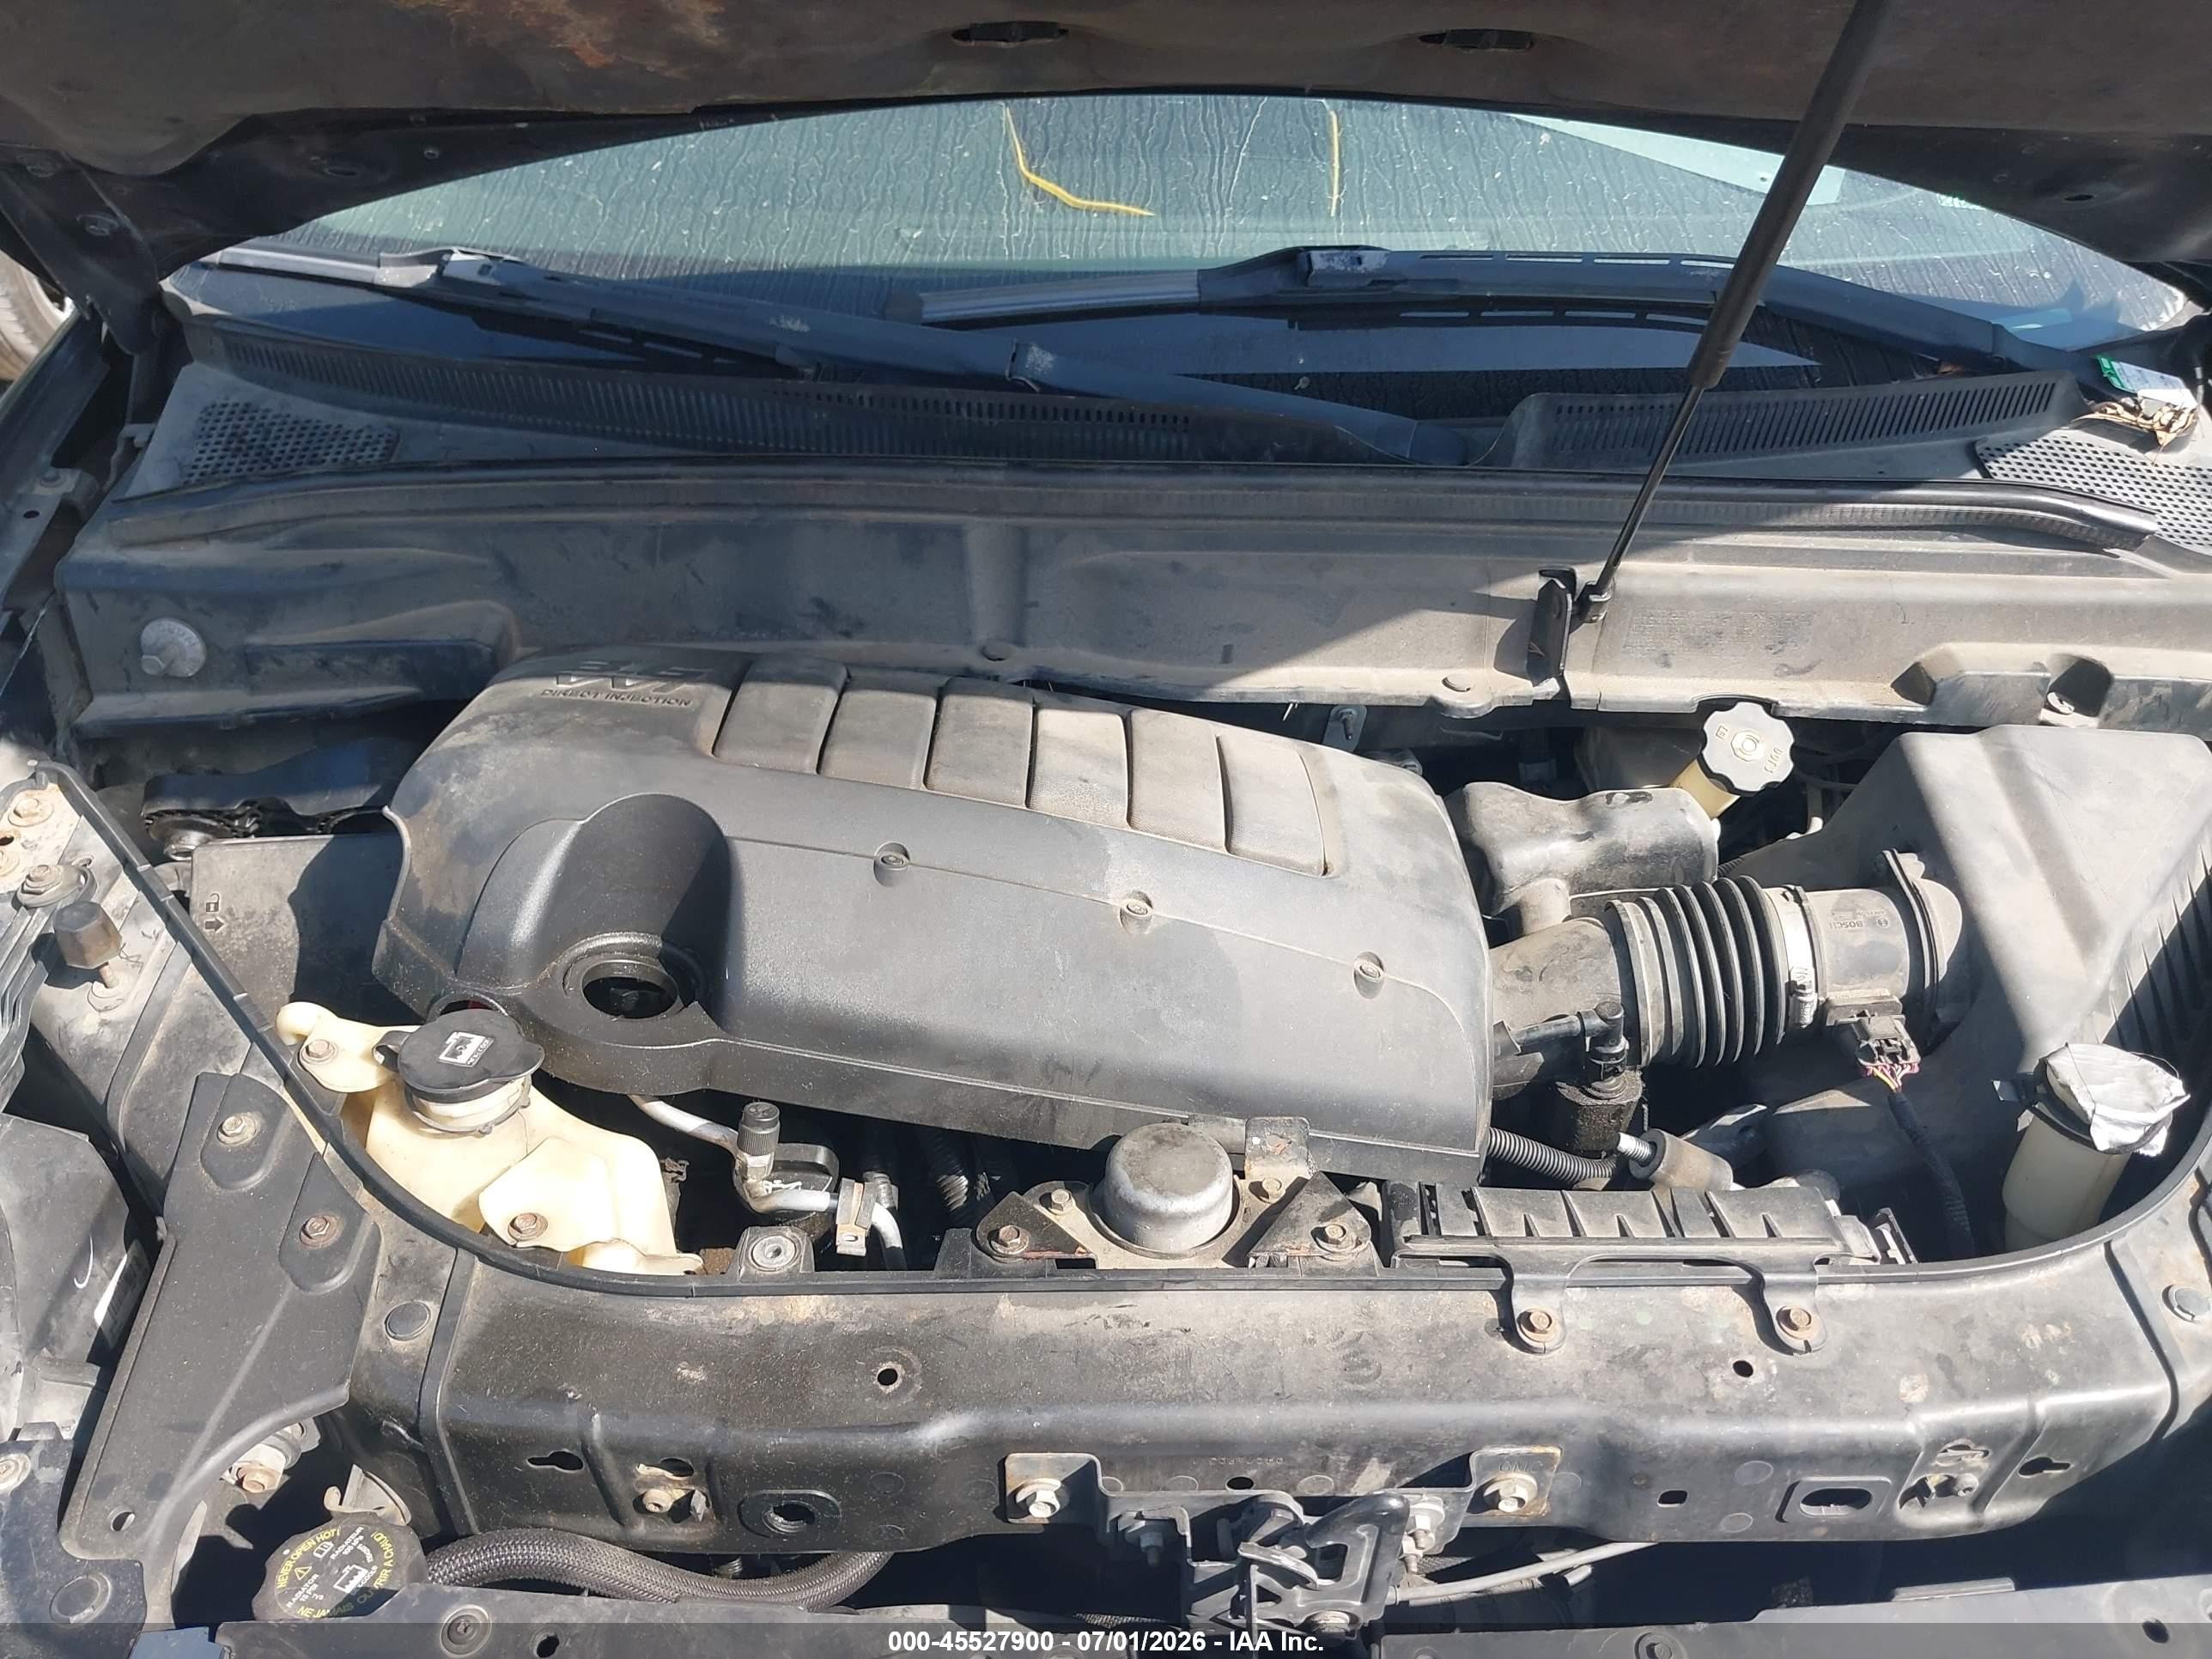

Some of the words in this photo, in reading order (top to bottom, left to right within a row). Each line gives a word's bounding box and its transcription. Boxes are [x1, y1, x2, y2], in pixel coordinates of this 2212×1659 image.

[540, 689, 599, 700] DIRECT
[604, 693, 693, 706] INJECTION
[1830, 920, 1863, 929] BOSCH
[276, 1555, 296, 1590] NEVER
[290, 1538, 317, 1563] OPEN
[315, 1527, 341, 1543] HOT!
[330, 1526, 364, 1559] RADIATEUR
[285, 1573, 319, 1608] RADIATOR
[297, 1605, 312, 1618] NE
[370, 1531, 395, 1559] CHAUD!
[299, 1591, 309, 1602] 15
[307, 1583, 319, 1595] PSI
